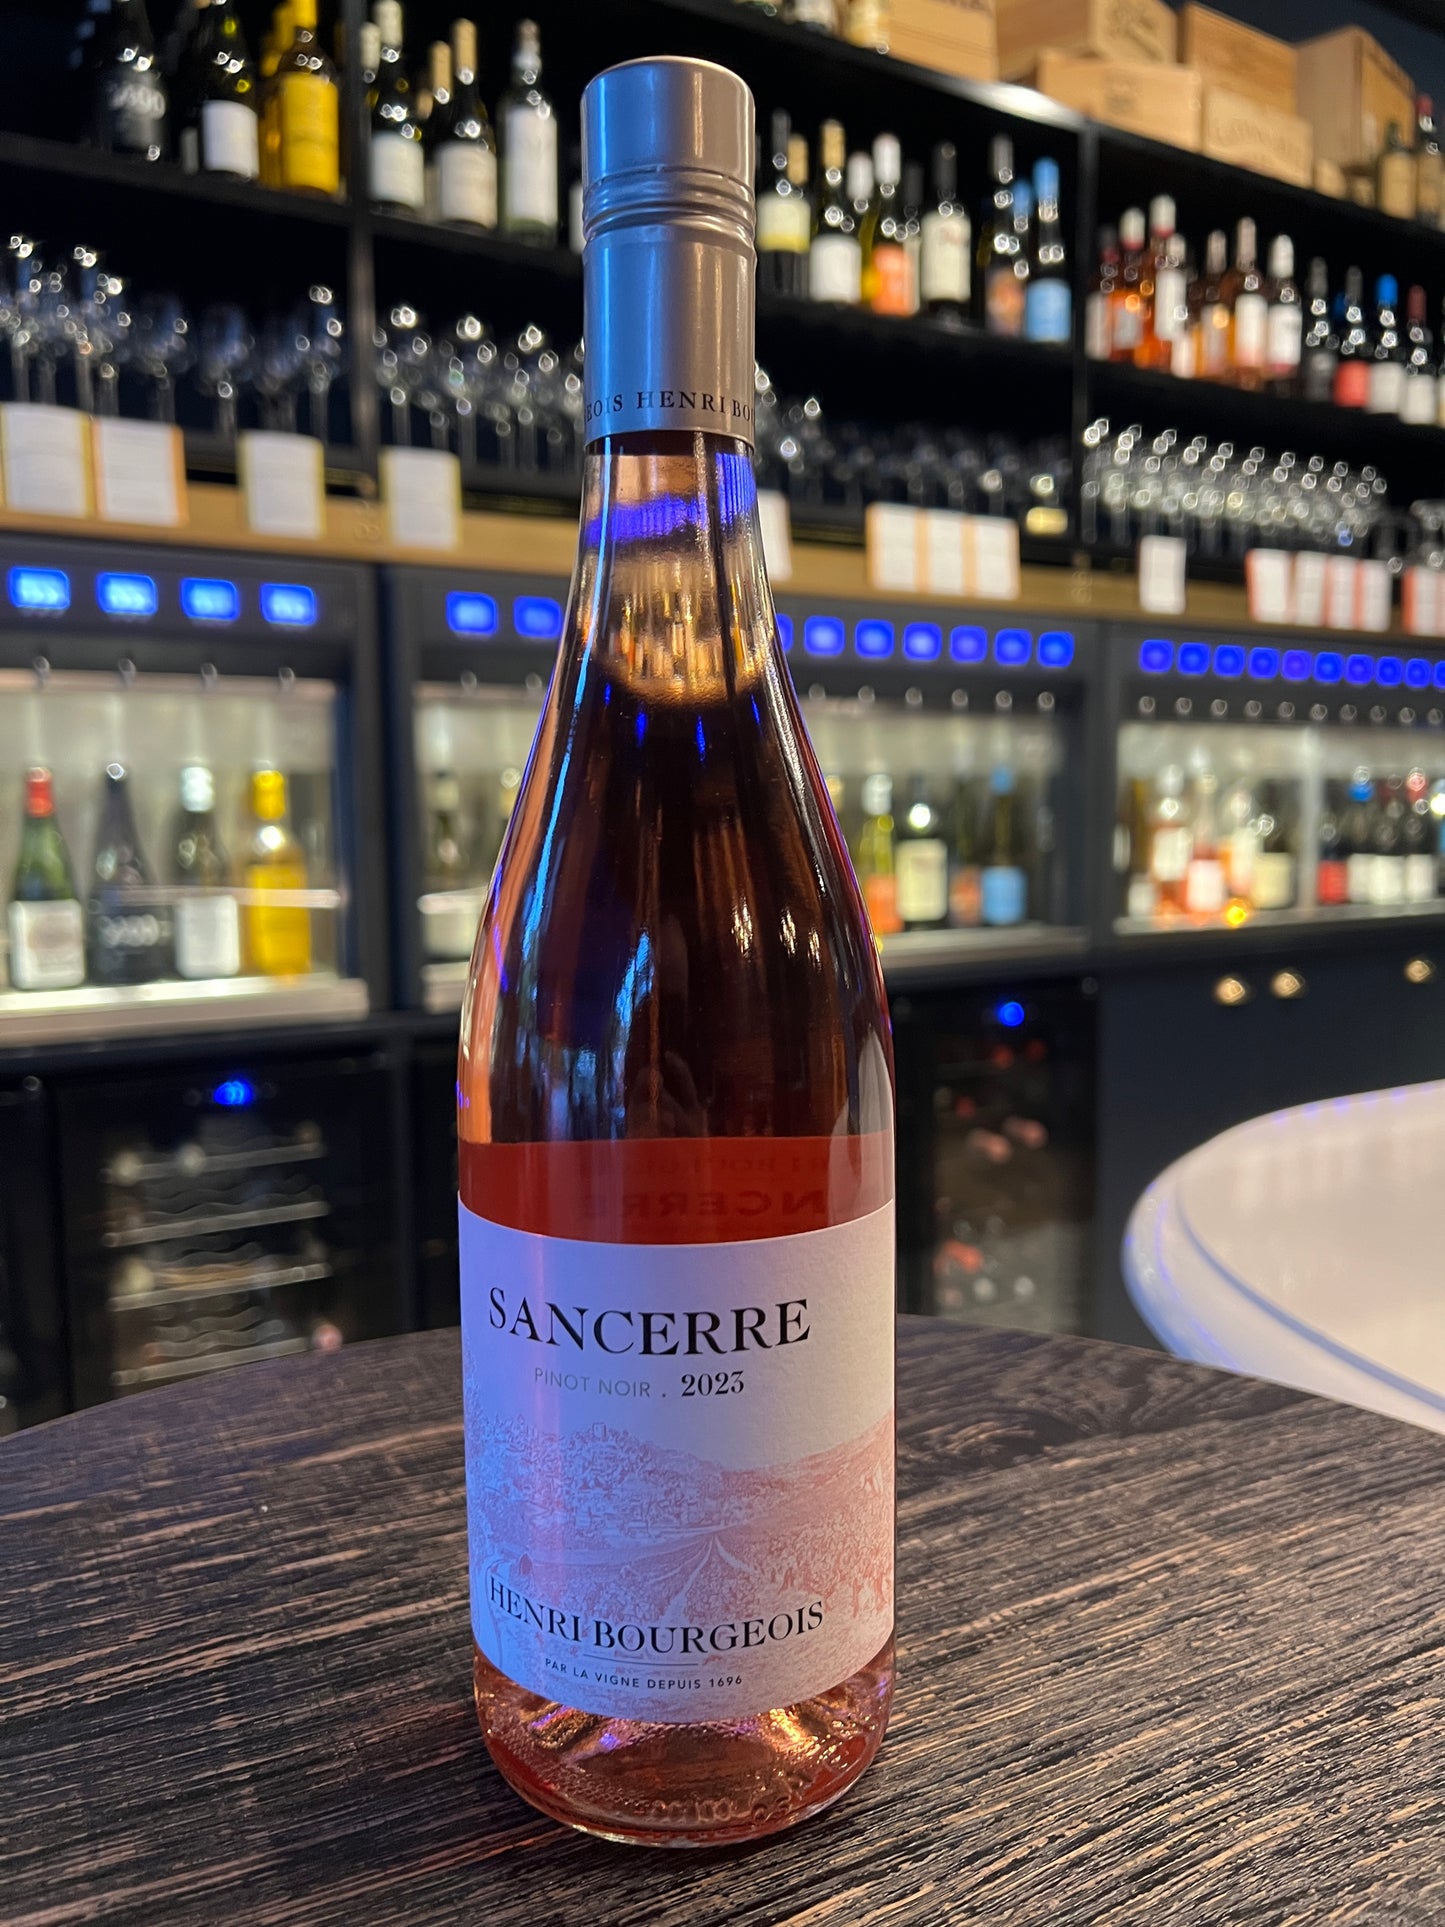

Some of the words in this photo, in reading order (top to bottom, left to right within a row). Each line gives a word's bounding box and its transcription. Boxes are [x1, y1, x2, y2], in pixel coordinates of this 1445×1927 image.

[636, 390, 726, 413] HENRI
[489, 1287, 811, 1355] SANCERRE
[535, 1367, 590, 1391] PINOT
[598, 1378, 650, 1398] NOIR
[681, 1371, 744, 1397] 2023
[490, 1576, 582, 1642] HENRI
[593, 1601, 824, 1653] BOURGEOIS
[545, 1658, 568, 1673] PAR
[573, 1669, 589, 1679] LA
[595, 1673, 640, 1688] VIGNE
[647, 1679, 701, 1690] DEPUIS
[709, 1675, 743, 1687] 1696
